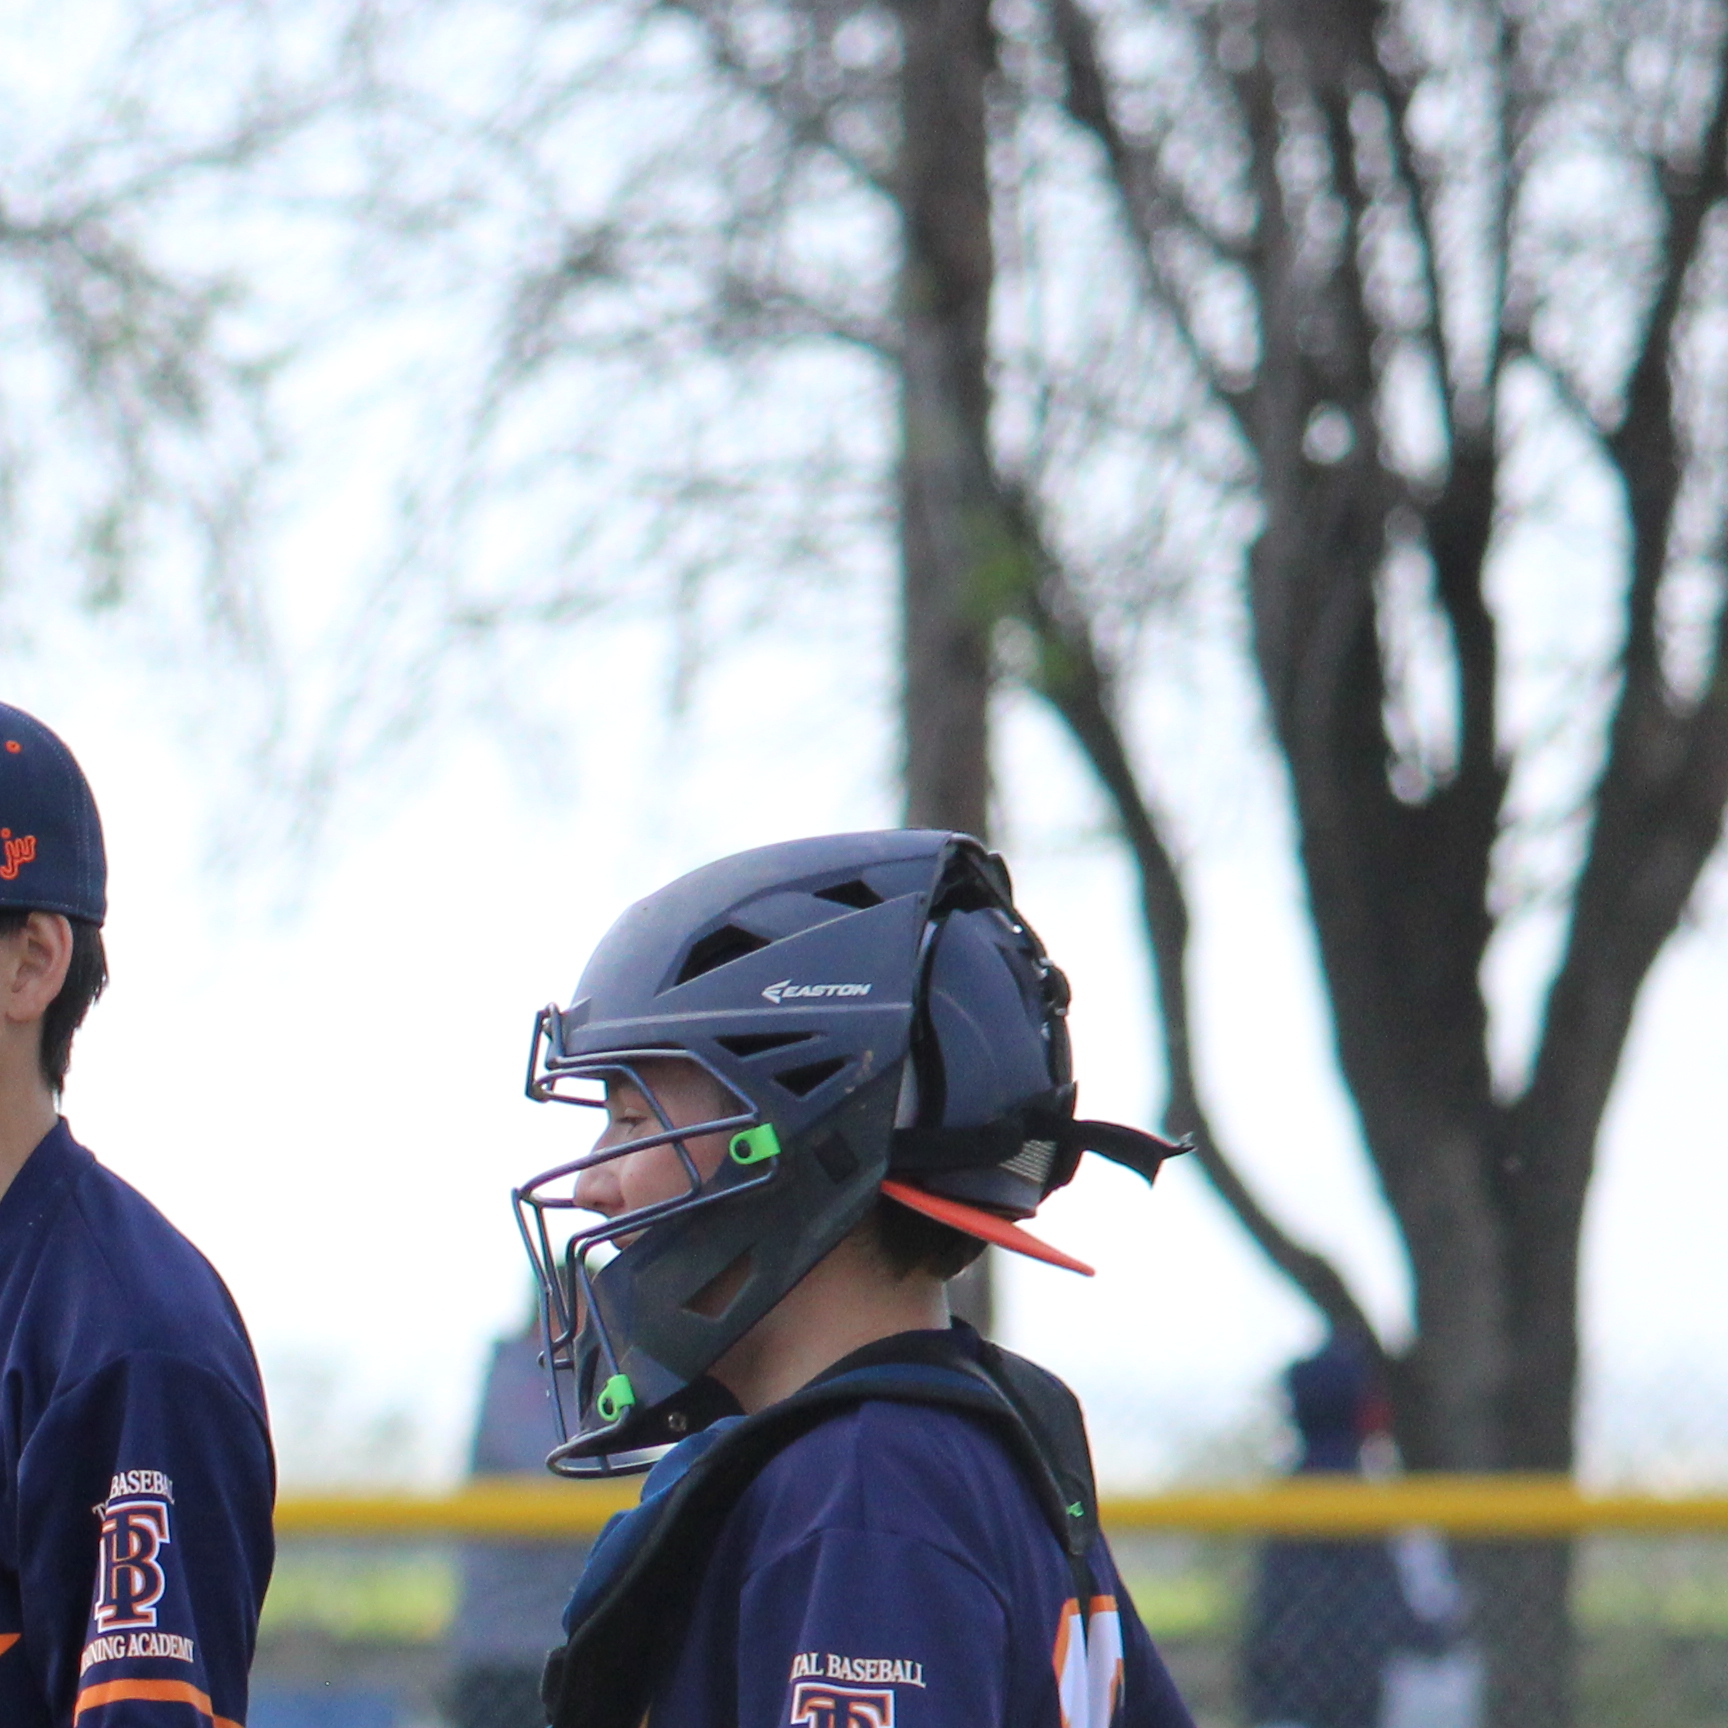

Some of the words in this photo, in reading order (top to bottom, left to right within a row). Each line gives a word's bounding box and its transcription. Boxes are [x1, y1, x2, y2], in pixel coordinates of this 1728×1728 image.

[781, 983, 873, 998] EASTON
[109, 1470, 175, 1504] BASEBA
[127, 1632, 194, 1664] ACADEMY
[790, 1653, 824, 1682] TAL
[827, 1654, 926, 1688] BASEBALL
